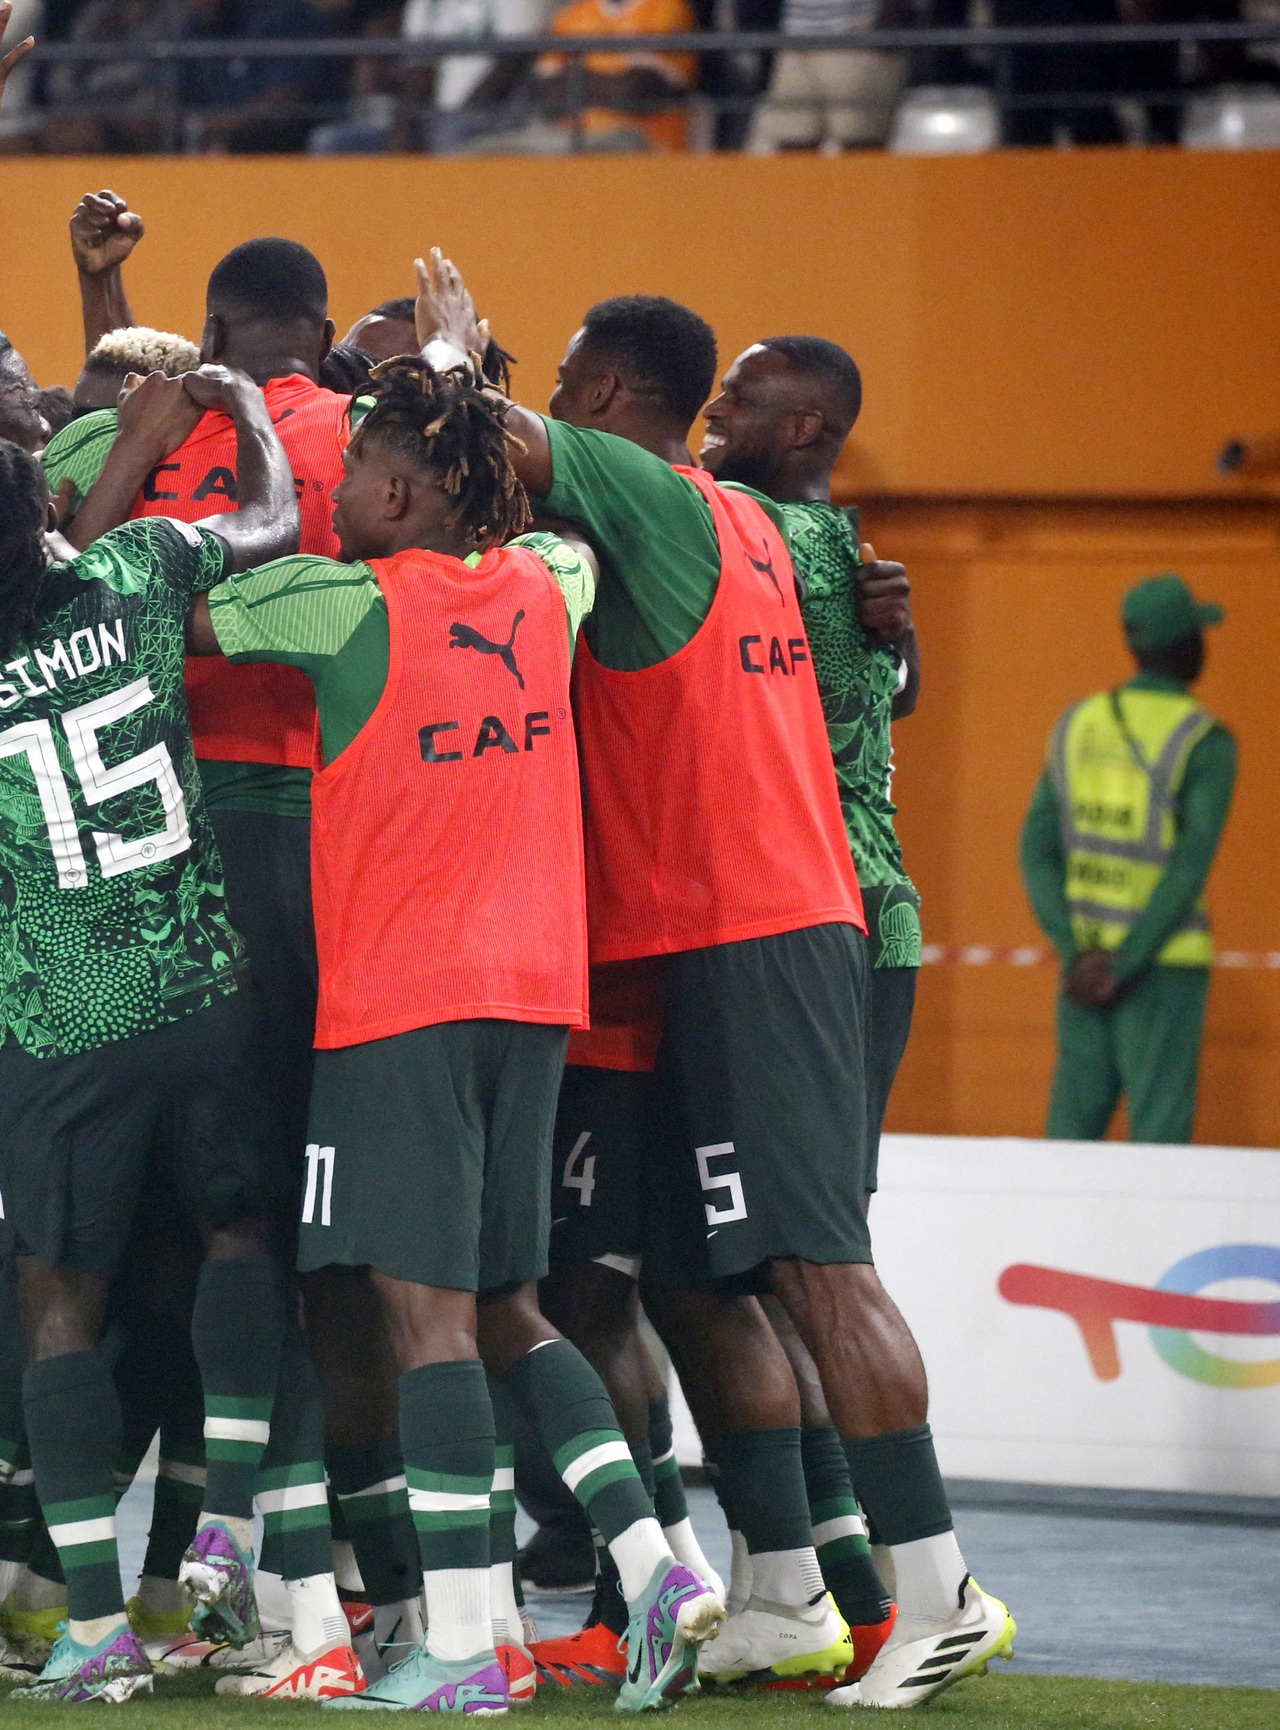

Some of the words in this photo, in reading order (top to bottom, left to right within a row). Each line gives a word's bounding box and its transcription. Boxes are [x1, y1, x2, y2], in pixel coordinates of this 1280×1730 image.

[739, 635, 807, 675] CAF
[418, 711, 551, 764] CAF
[302, 1143, 336, 1227] 11
[562, 1131, 596, 1207] 4
[695, 1141, 748, 1226] 5
[778, 1632, 798, 1641] COPA
